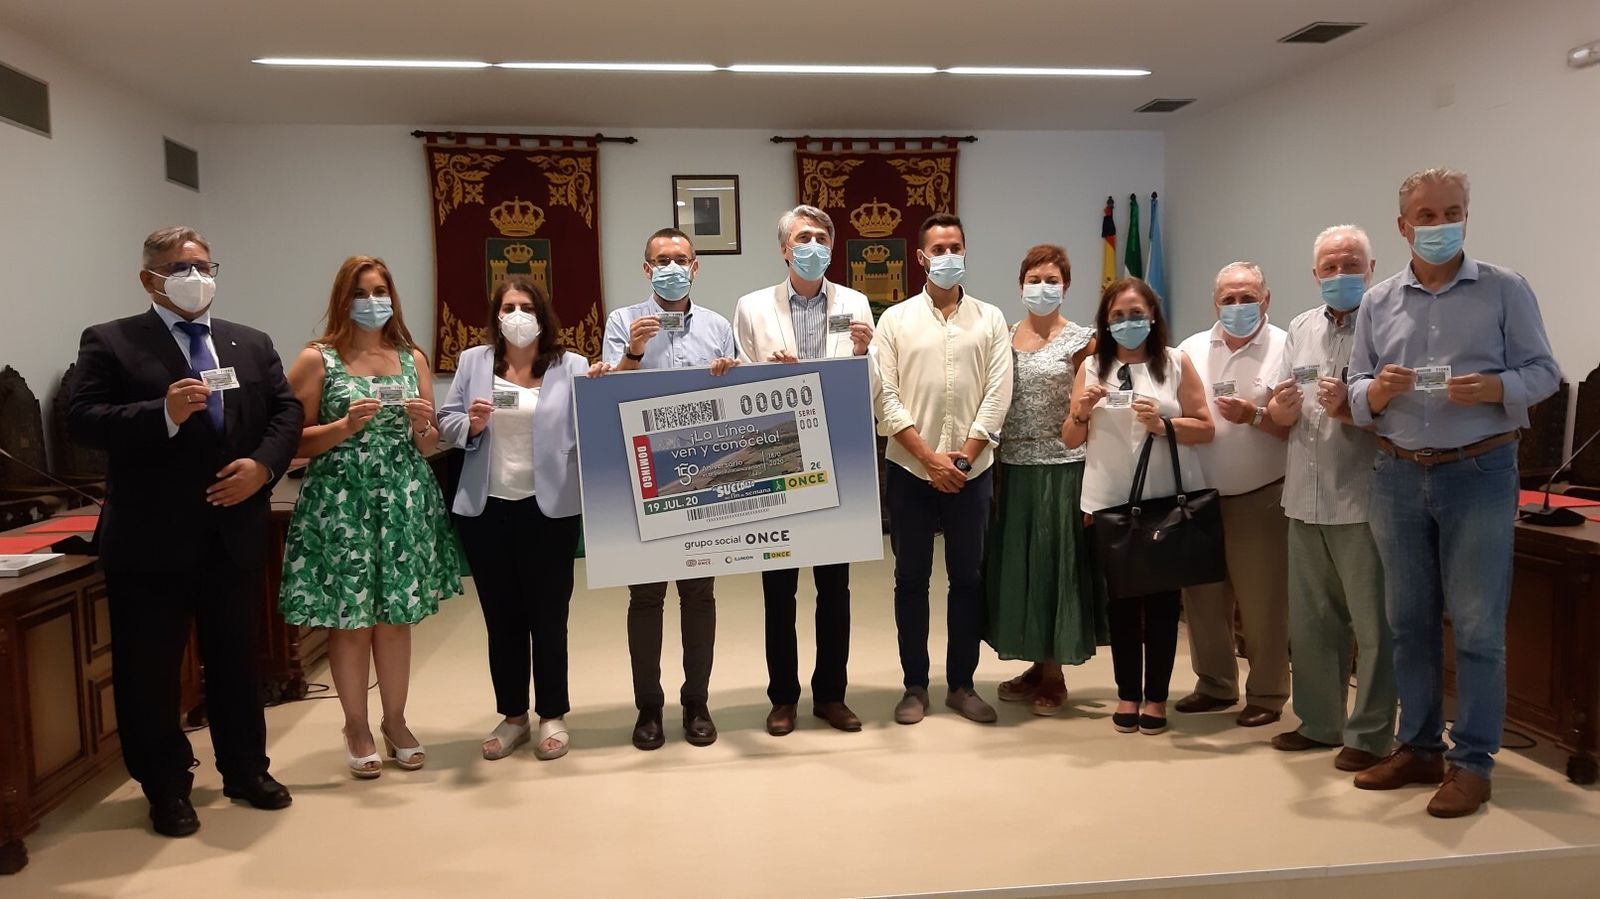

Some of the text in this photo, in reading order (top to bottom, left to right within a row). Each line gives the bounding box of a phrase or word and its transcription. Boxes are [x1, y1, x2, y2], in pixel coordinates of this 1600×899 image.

[740, 385, 813, 415] 00000
[799, 408, 816, 417] SERIE
[800, 417, 819, 430] 000
[691, 424, 759, 445] ¡La Línea,
[671, 430, 780, 459] ven y conócela!
[637, 445, 653, 488] DOMINGO
[674, 463, 699, 485] 150
[702, 460, 743, 472] Aniversario
[810, 461, 822, 470] 2€
[788, 473, 825, 488] ONCE
[648, 496, 698, 513] 19 JUL. 20
[684, 530, 790, 550] grupo social ONCE
[771, 551, 790, 559] ONCE
